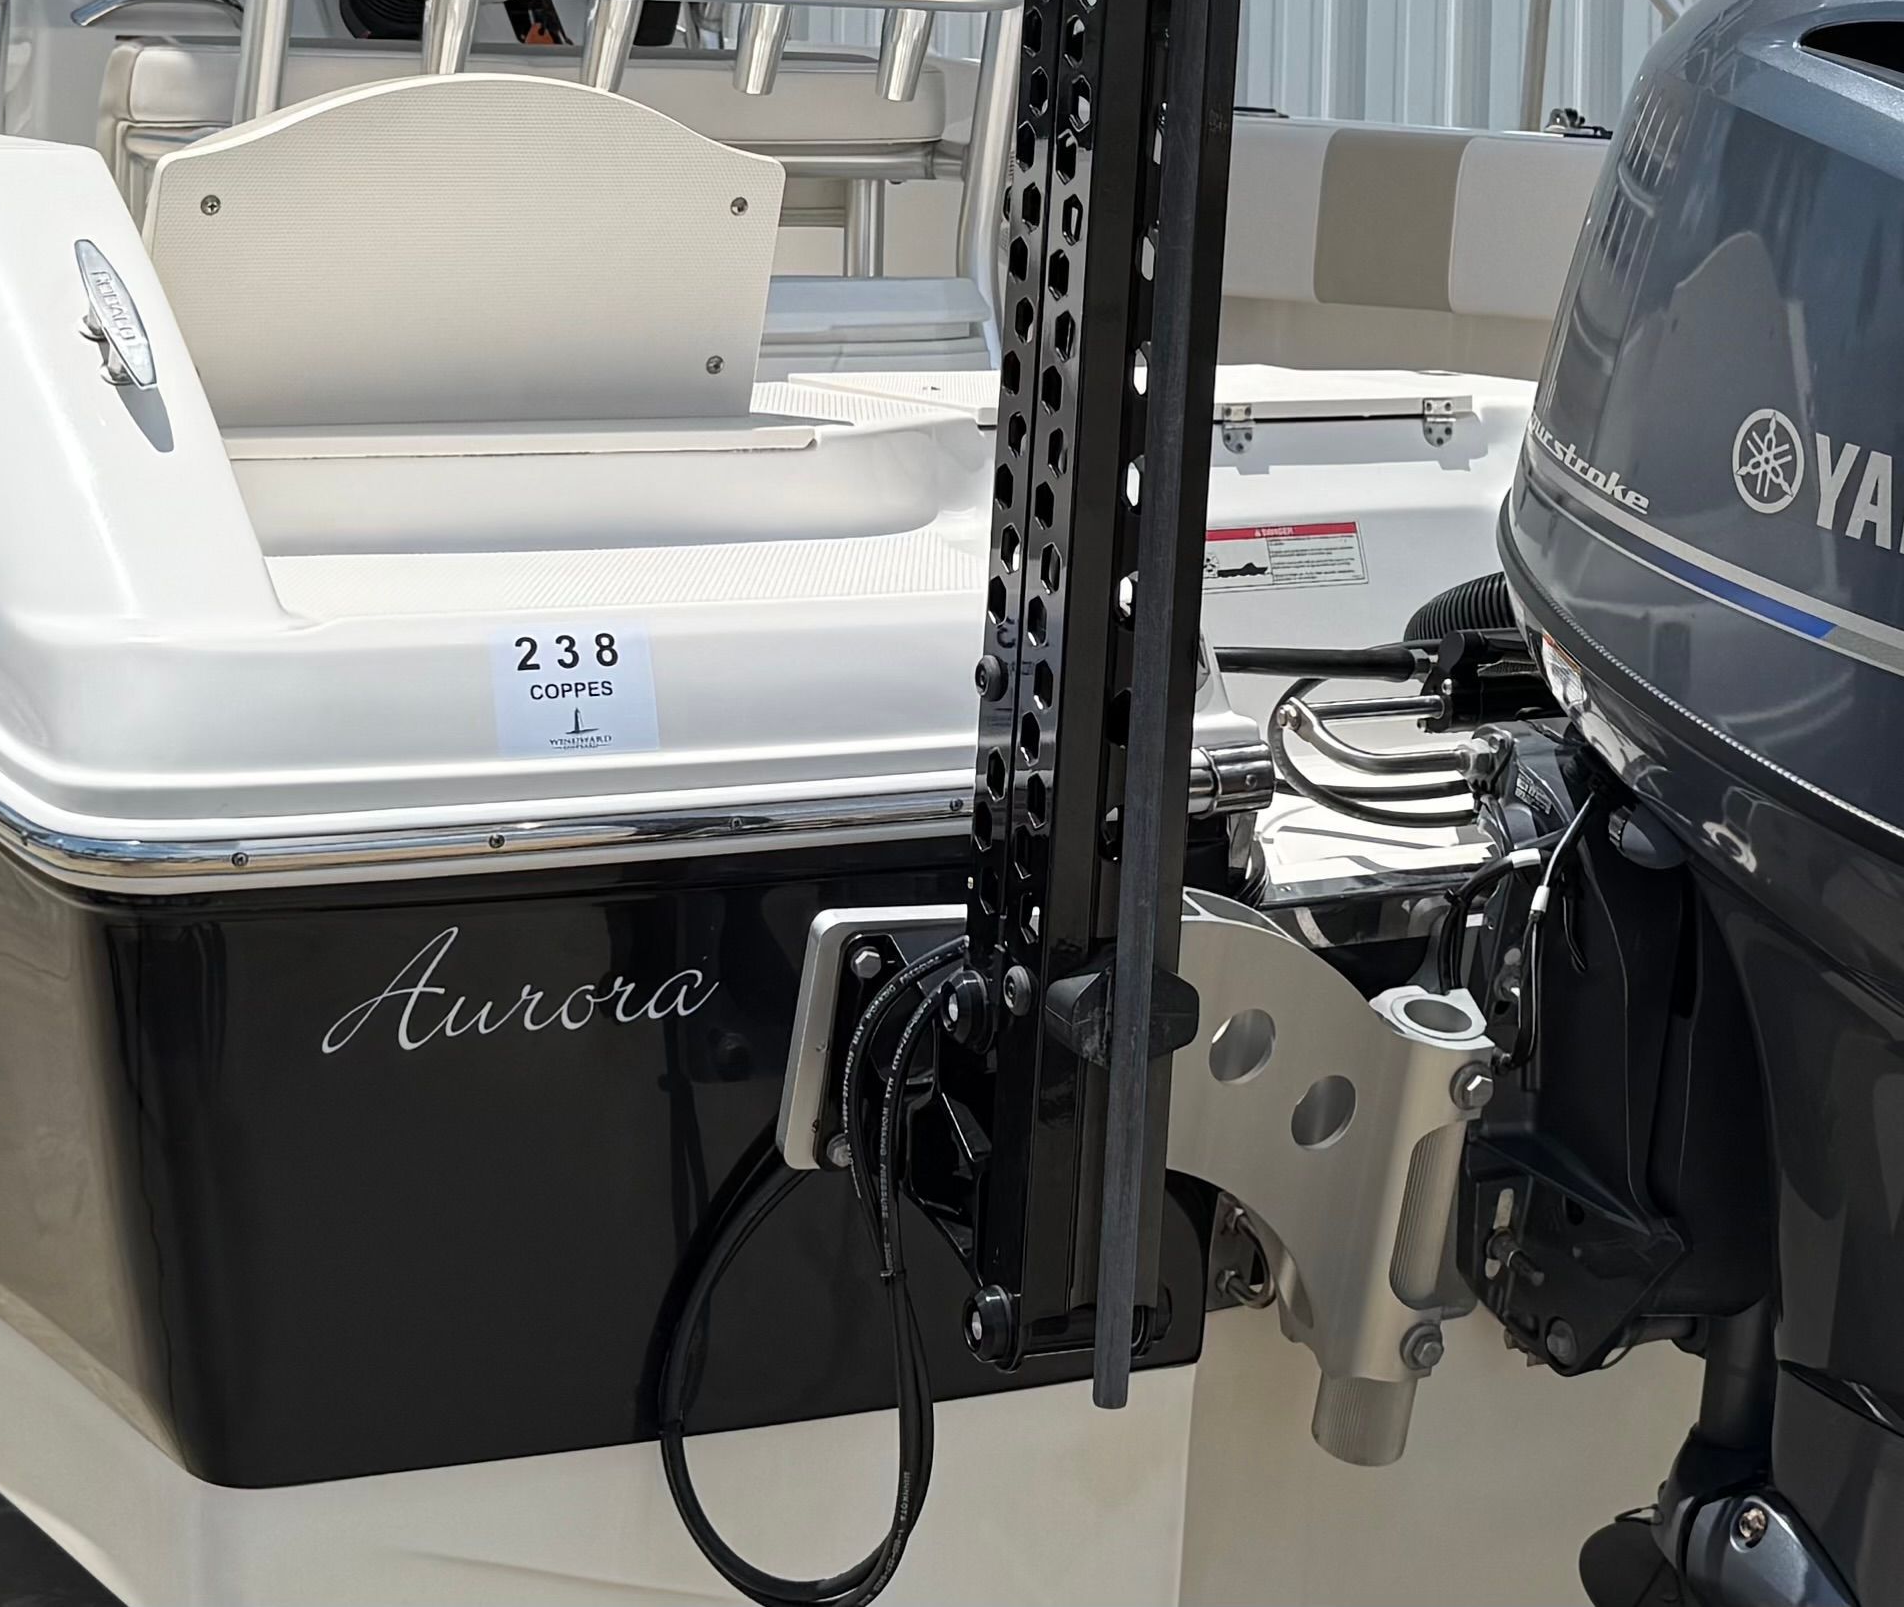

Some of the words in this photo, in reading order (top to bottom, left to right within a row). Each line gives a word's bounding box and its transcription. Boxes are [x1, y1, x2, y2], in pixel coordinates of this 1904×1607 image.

[1555, 439, 1649, 515] stroke
[530, 680, 614, 700] COPPES
[321, 925, 720, 1054] Aurora
